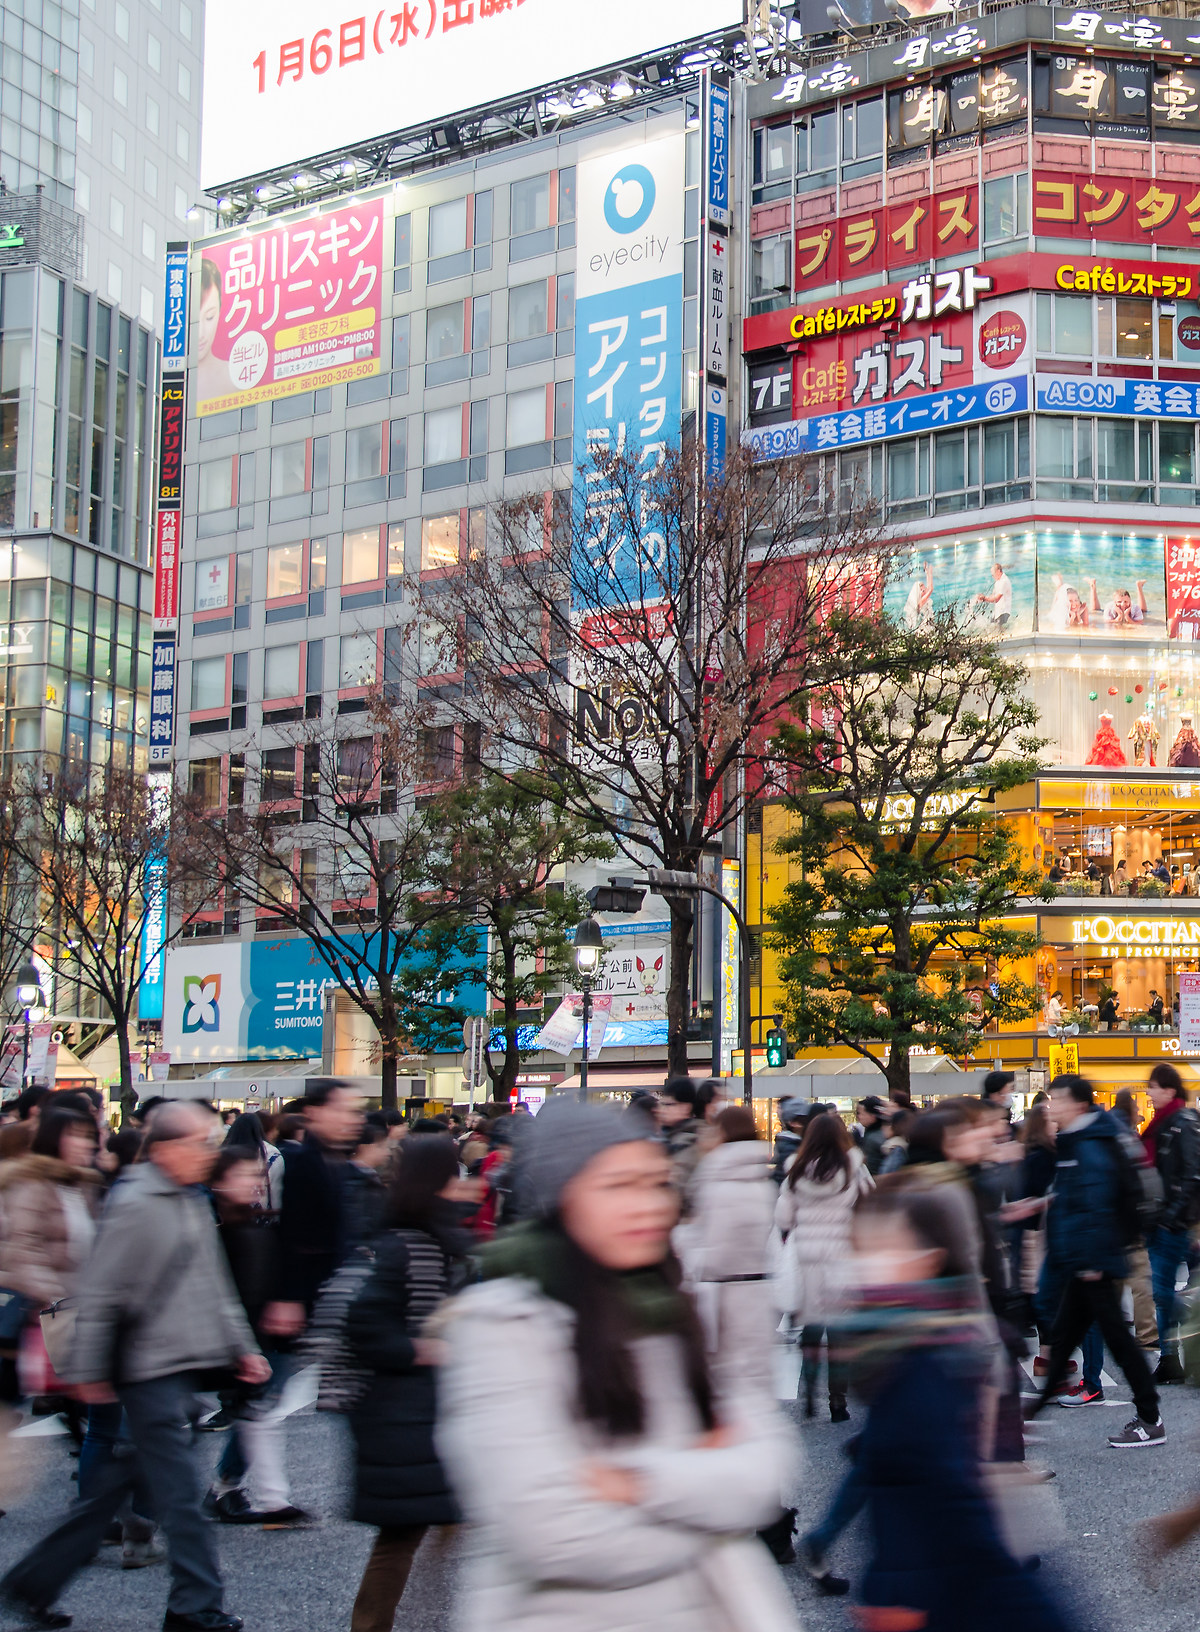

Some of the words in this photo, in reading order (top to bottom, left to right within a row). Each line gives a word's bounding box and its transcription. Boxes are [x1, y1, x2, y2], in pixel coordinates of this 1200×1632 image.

[1055, 12, 1163, 48] 月の宴
[892, 25, 981, 68] 月の宴
[1055, 56, 1077, 71] 9F
[772, 62, 853, 103] 月の宴
[905, 86, 922, 102] 9F
[1055, 68, 1199, 121] 月の宴
[712, 103, 725, 201] 東急リバブル
[712, 208, 725, 220] 9F
[798, 194, 974, 276] プライス
[225, 216, 379, 295] 品川スキン
[589, 234, 669, 277] eyecity
[225, 260, 377, 339] クリニック
[902, 266, 991, 323] ガスト
[168, 268, 184, 353] 東急リバブル
[712, 268, 724, 356] 献血ルーム
[298, 315, 350, 342] 美容皮フ科
[232, 344, 265, 364] 当ビル
[985, 334, 1022, 356] ガスト
[168, 359, 181, 368] 9F
[238, 363, 260, 383] 4F
[312, 363, 374, 386] 0120-326-500
[712, 360, 722, 372] 6F
[802, 360, 848, 390] Café
[853, 335, 962, 405] ガスト
[753, 373, 791, 410] 7F
[802, 387, 847, 407] レストラン
[988, 388, 1013, 406] 6F
[1047, 382, 1115, 406] AEON
[817, 394, 976, 446] 英会話イーオン
[163, 406, 180, 481] アメリカン
[161, 486, 180, 497] 8F
[160, 511, 177, 569] 外貨両替
[159, 618, 173, 628] 7F
[151, 646, 175, 740] 加藤眼科
[152, 748, 170, 759] 5F
[1101, 946, 1119, 958] EN
[1126, 946, 1199, 958] PROVENCE
[599, 959, 633, 973] チ公前
[594, 977, 637, 992] 血ルーム
[274, 1016, 323, 1029] SUMITOMO
